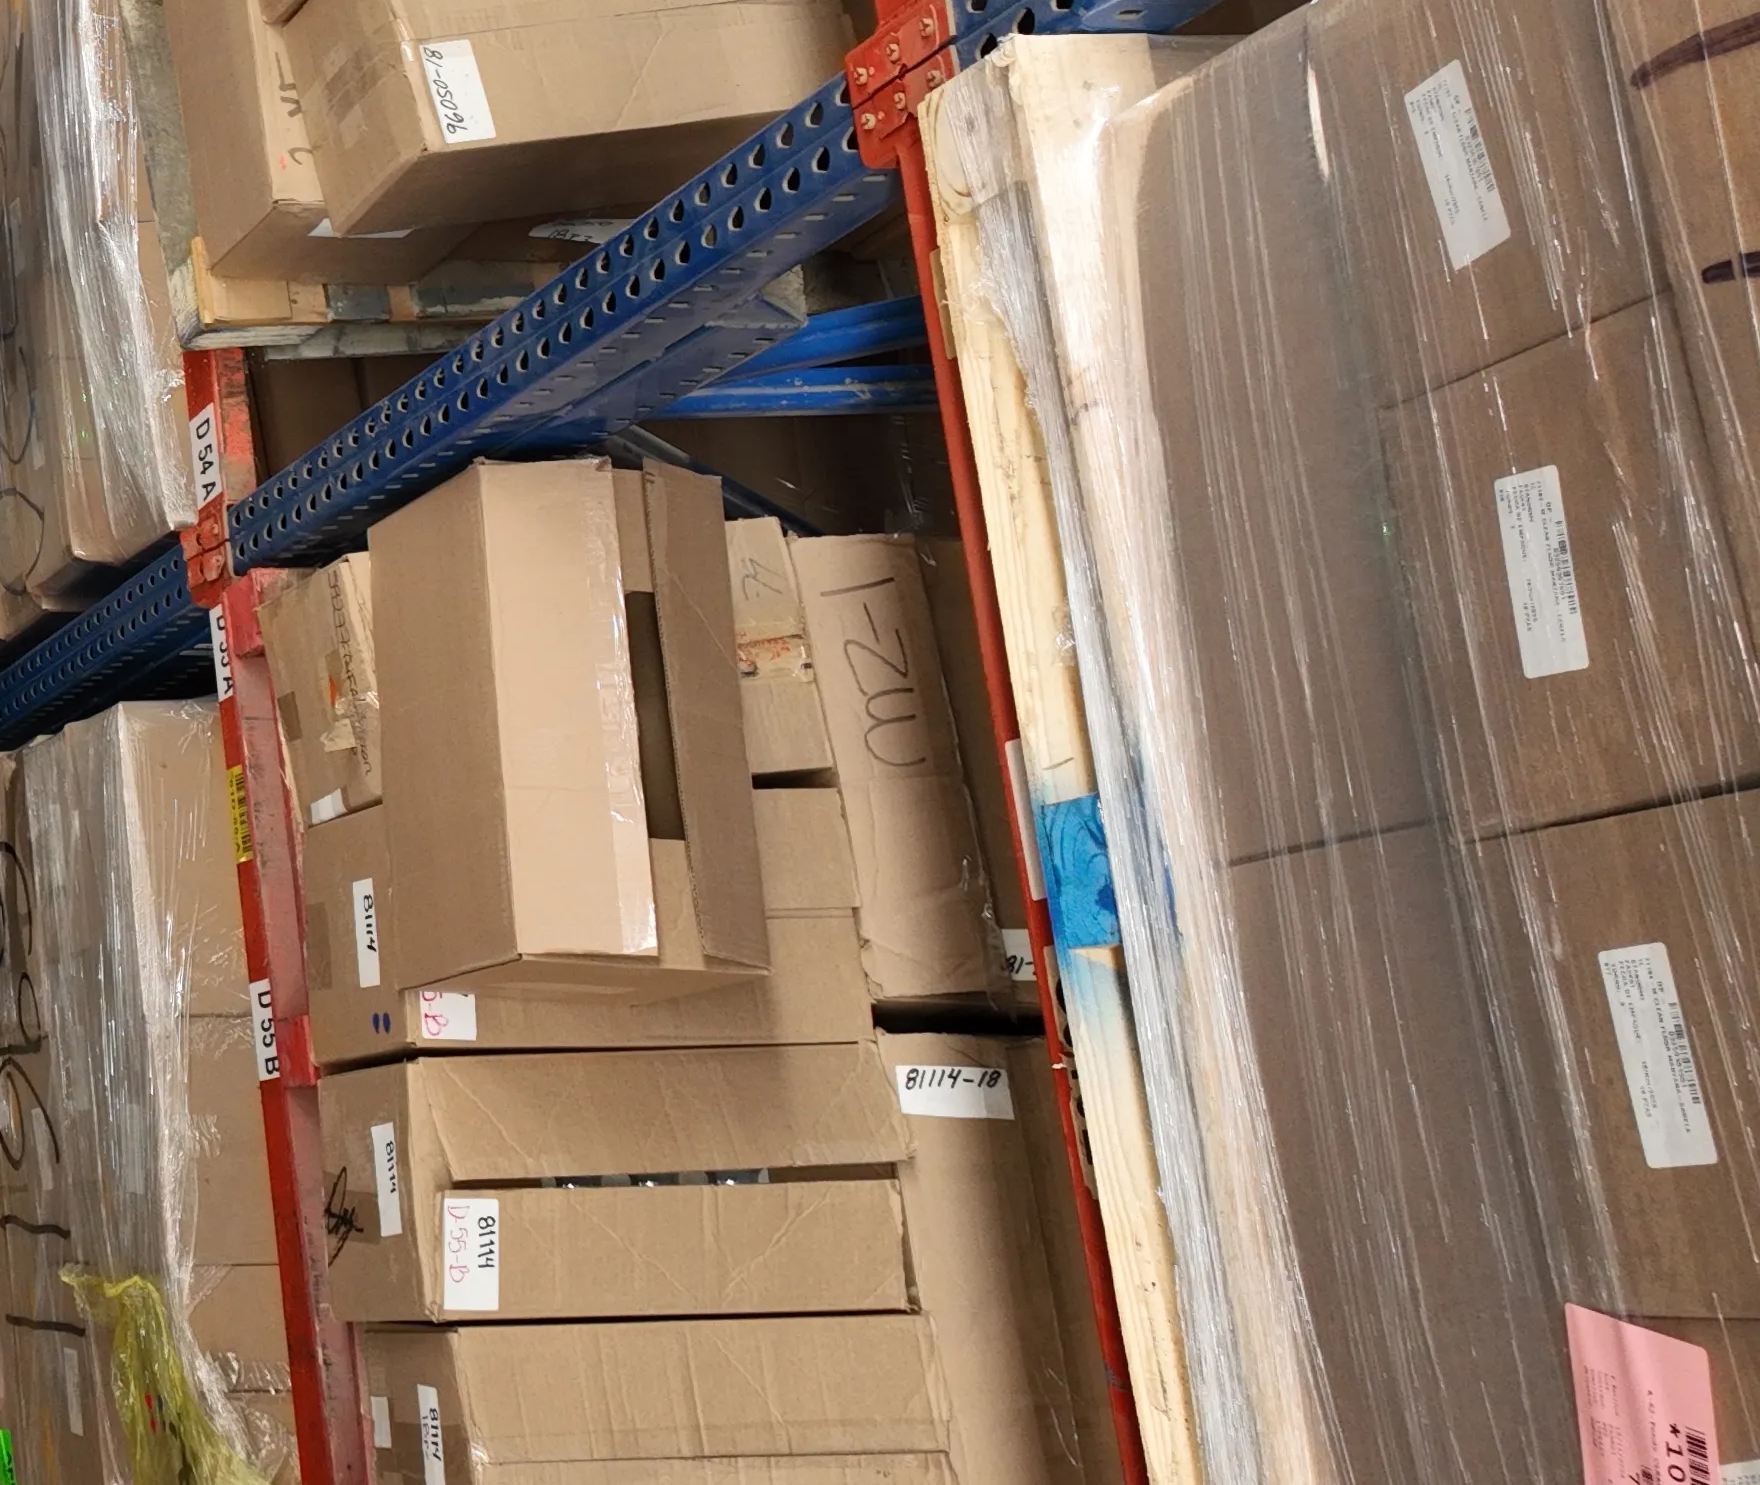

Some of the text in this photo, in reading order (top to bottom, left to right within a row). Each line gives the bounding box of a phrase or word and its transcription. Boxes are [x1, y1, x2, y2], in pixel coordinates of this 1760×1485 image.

[423, 47, 467, 135] 96050-18
[195, 417, 216, 502] D 54 A
[363, 894, 378, 954] 81114
[257, 991, 279, 1077] D 55 B
[906, 1068, 1002, 1091] 81114-18
[385, 1140, 398, 1195] 81114
[449, 1205, 470, 1283] D-55-B
[478, 1216, 496, 1270] 81114
[429, 1408, 443, 1461] 81114
